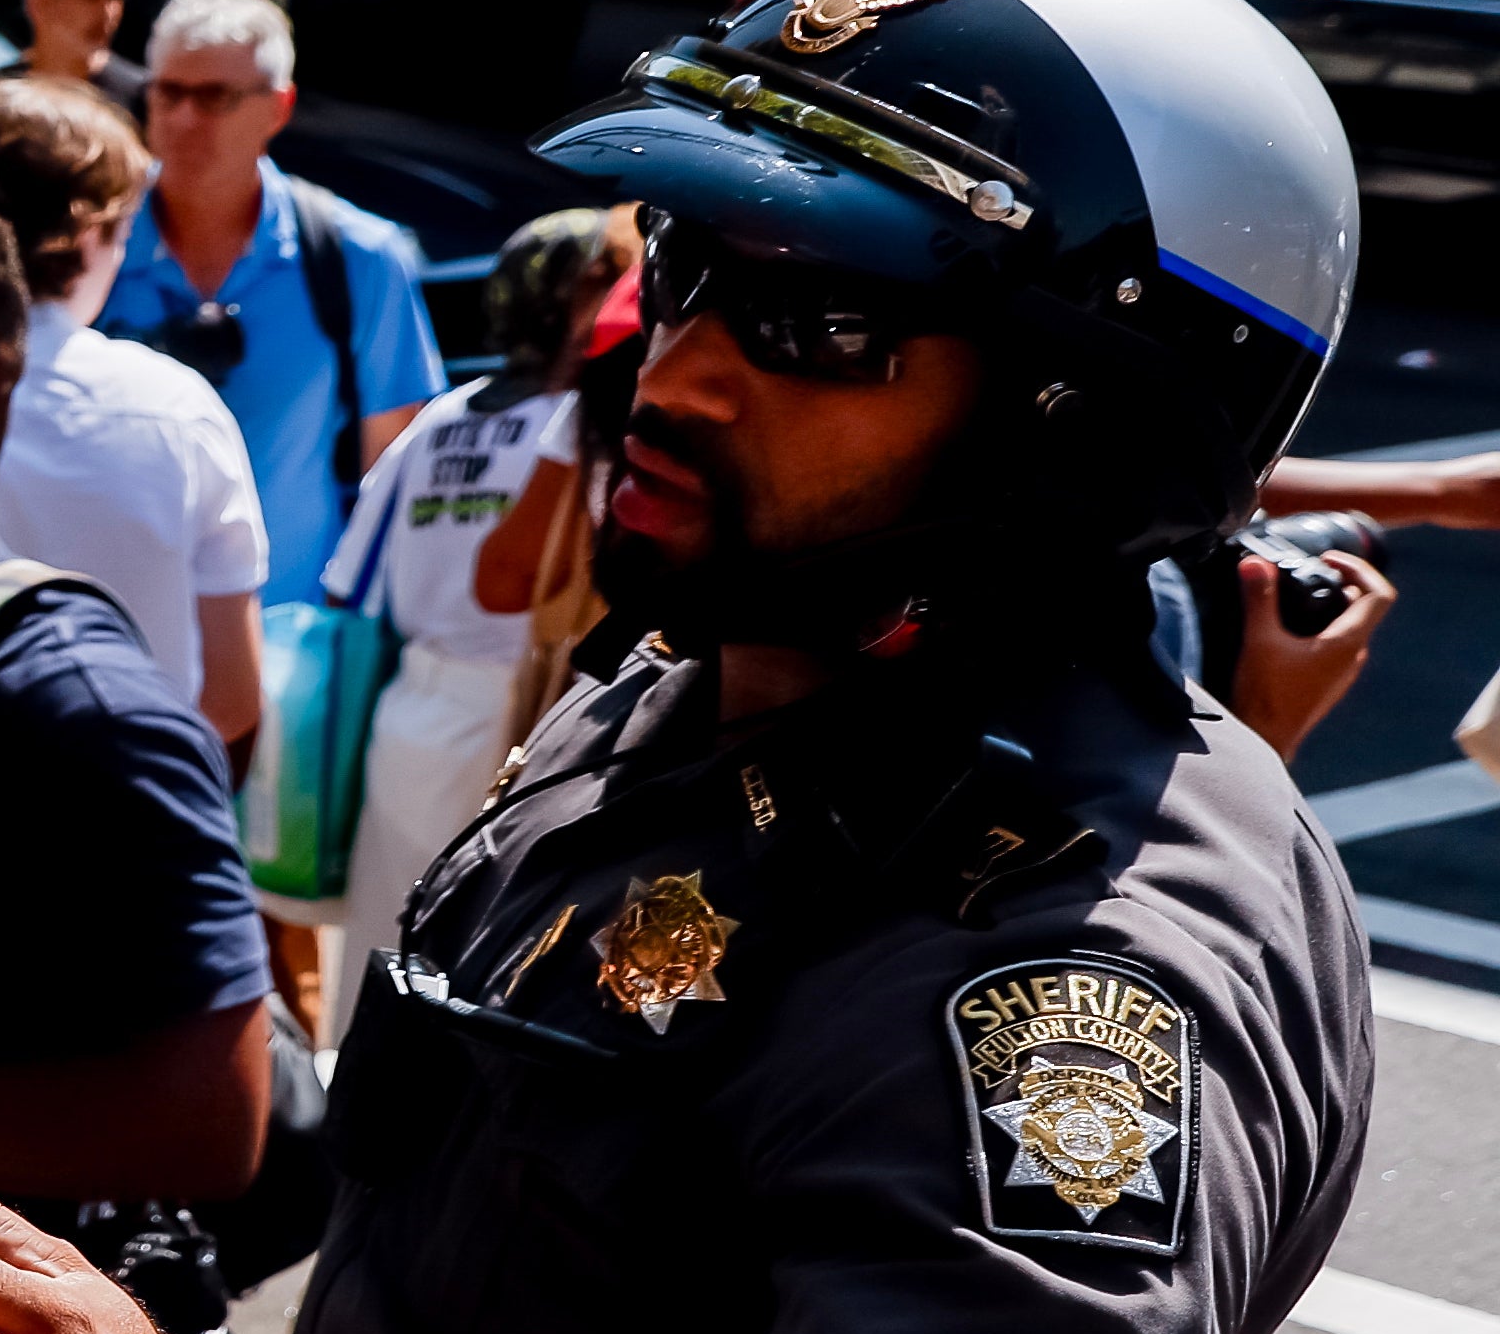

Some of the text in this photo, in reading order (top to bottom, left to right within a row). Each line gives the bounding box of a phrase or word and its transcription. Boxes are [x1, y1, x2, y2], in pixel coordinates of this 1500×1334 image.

[959, 974, 1179, 1034] SHERIFF
[979, 1018, 1170, 1073] FULTON COUNTY
